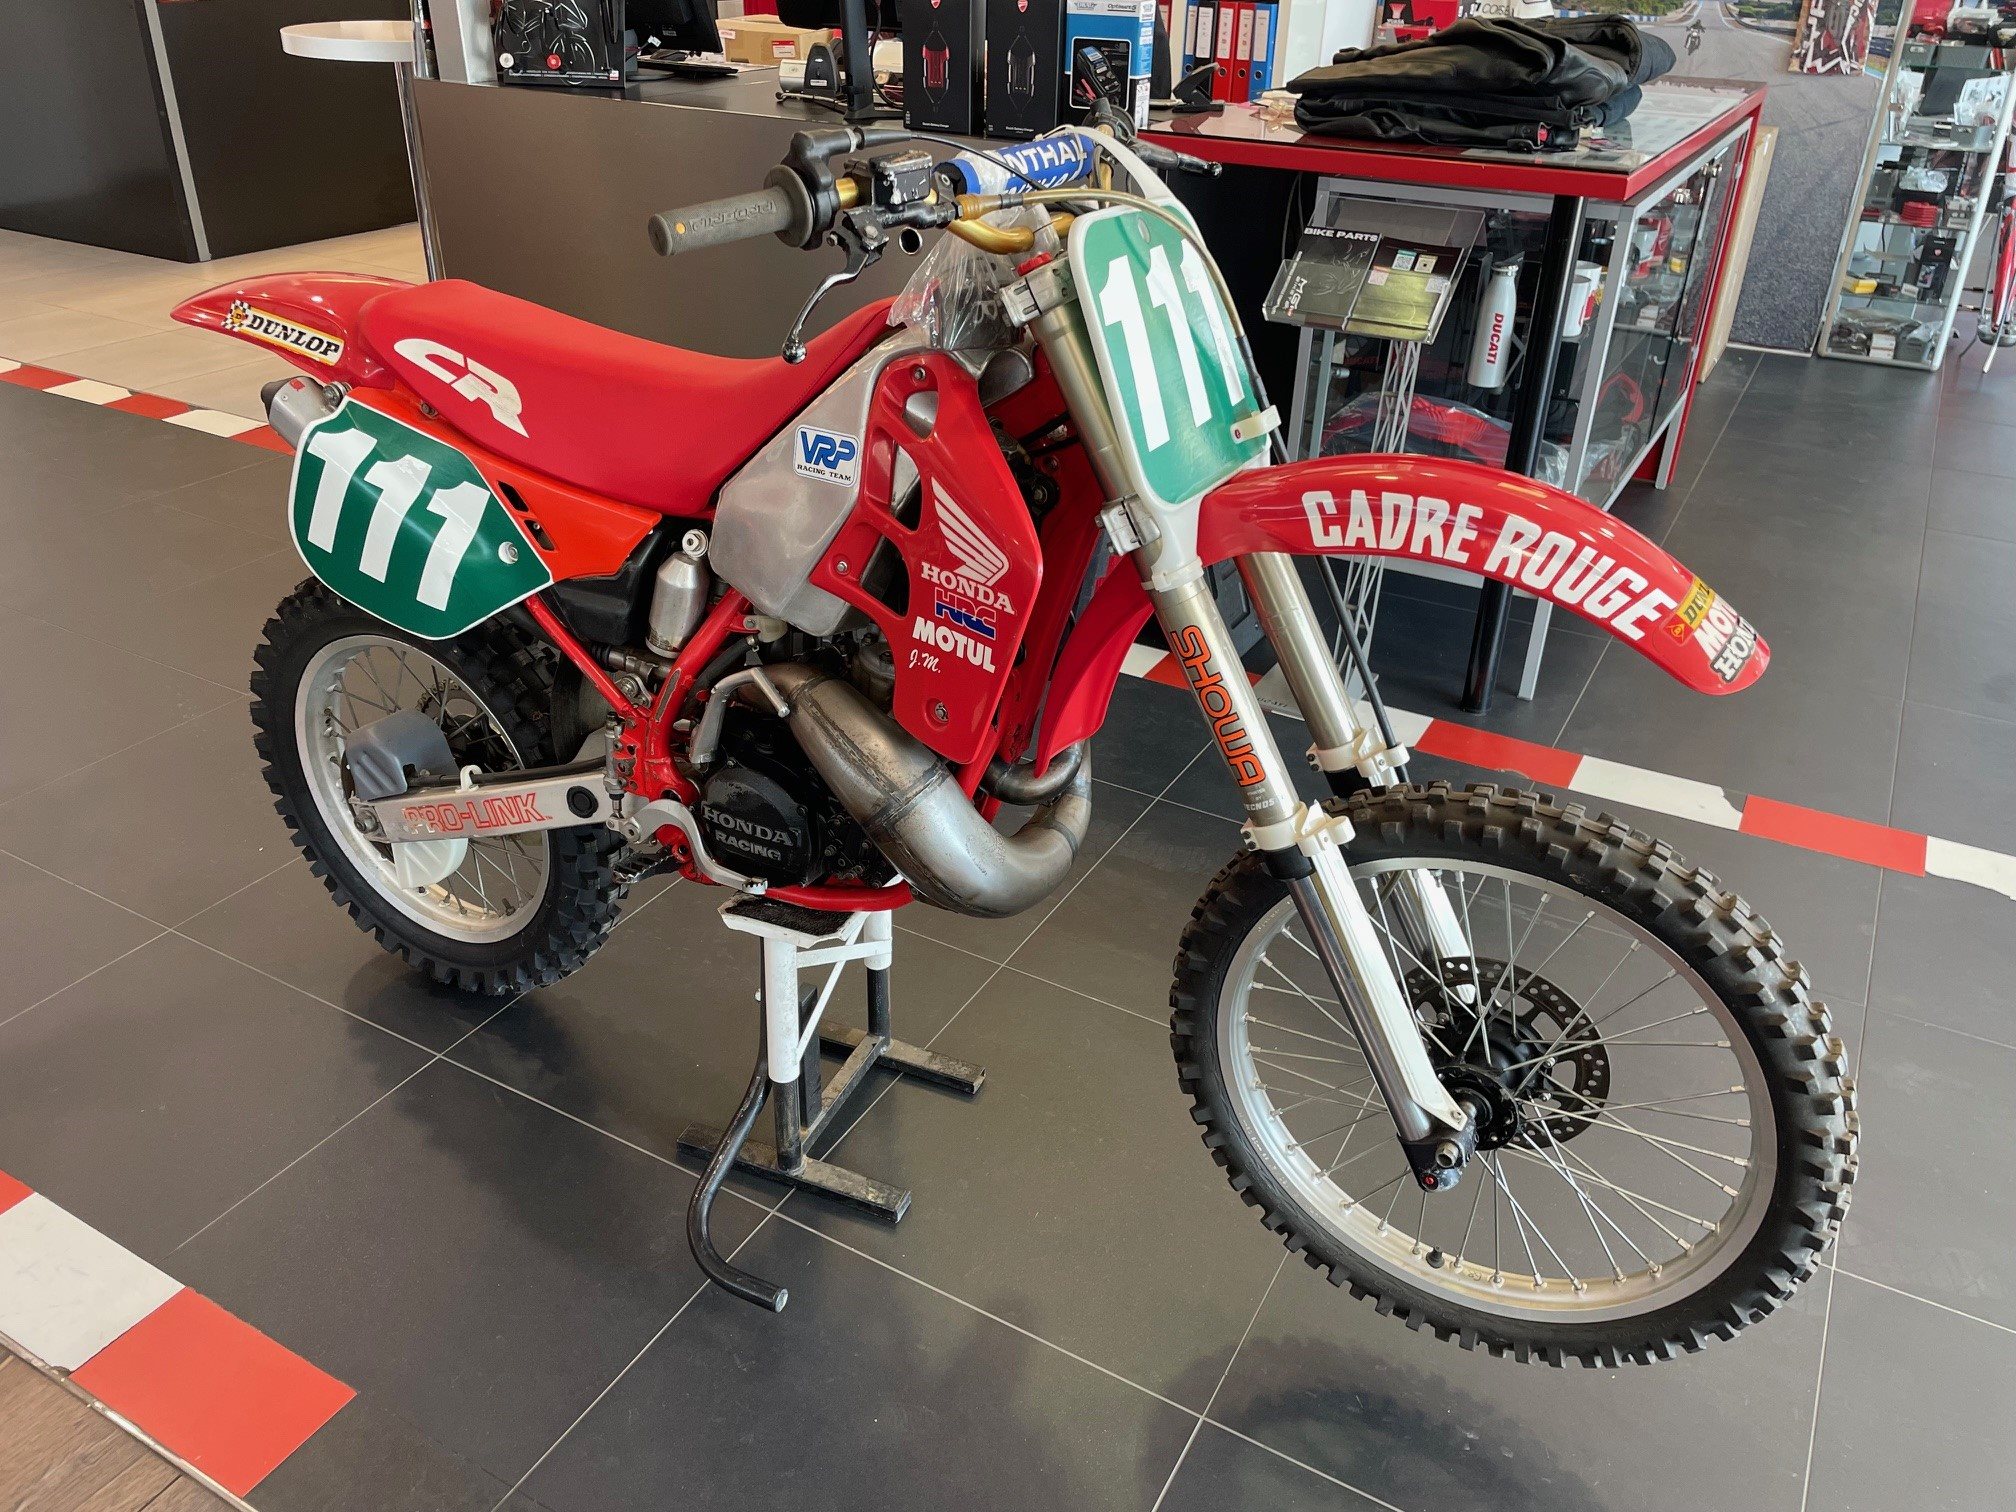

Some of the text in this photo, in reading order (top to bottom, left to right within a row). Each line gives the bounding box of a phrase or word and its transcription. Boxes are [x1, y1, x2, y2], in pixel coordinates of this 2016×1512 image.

[1304, 227, 1379, 242] BIKE PARTS
[246, 312, 340, 358] DUNLOP
[1099, 238, 1245, 452] 111
[1487, 312, 1504, 364] DUCATI
[393, 338, 529, 438] CR
[797, 463, 852, 481] RACING TEAM
[801, 430, 855, 470] VRP
[307, 428, 491, 611] 111
[921, 561, 1015, 615] HONDA
[1302, 489, 1677, 642] CADRE ROUGE
[935, 587, 996, 640] HRC
[912, 616, 996, 674] MOTUL
[1171, 625, 1265, 787] SHOWA
[702, 806, 793, 846] HONDA
[715, 829, 782, 861] RACING
